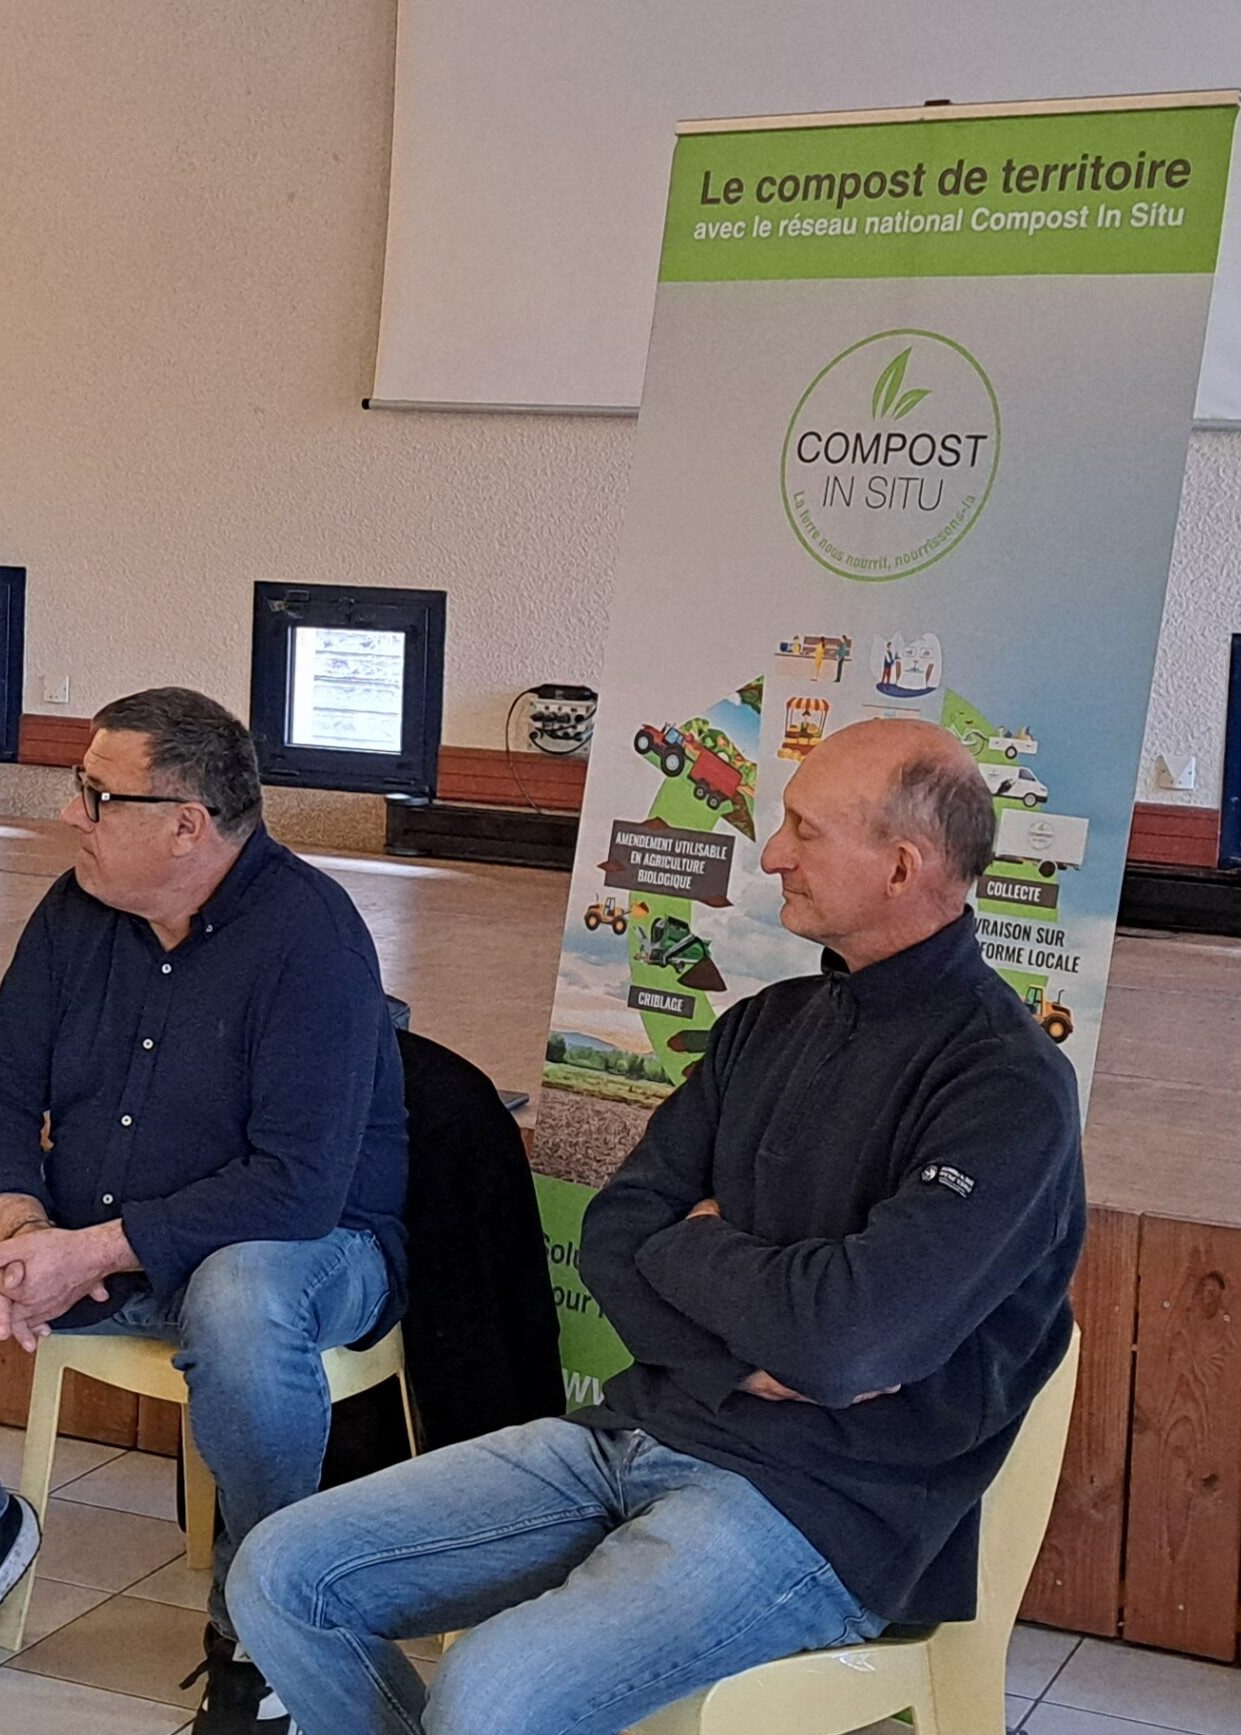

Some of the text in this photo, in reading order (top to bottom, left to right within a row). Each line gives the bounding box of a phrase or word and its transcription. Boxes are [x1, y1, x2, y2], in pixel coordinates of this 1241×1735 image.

[700, 151, 1191, 209] Le compost de territoire
[694, 202, 1185, 239] avec le réseau national Compost In Situ
[797, 431, 988, 467] COMPOST
[823, 475, 943, 511] IN SITU
[793, 490, 805, 509] La
[800, 509, 820, 540] terre
[819, 538, 845, 562] nous
[615, 831, 728, 860] AMENDEMENT UTILISABLE
[630, 851, 706, 875] EN AGRICULTURE
[637, 869, 692, 890] BIOLOGIQUE
[987, 881, 1042, 902] COLLECTE
[974, 918, 1066, 948] VRAISON SUR
[980, 941, 1081, 974] FORME LOCALE
[638, 991, 684, 1013] CRIBLAGE
